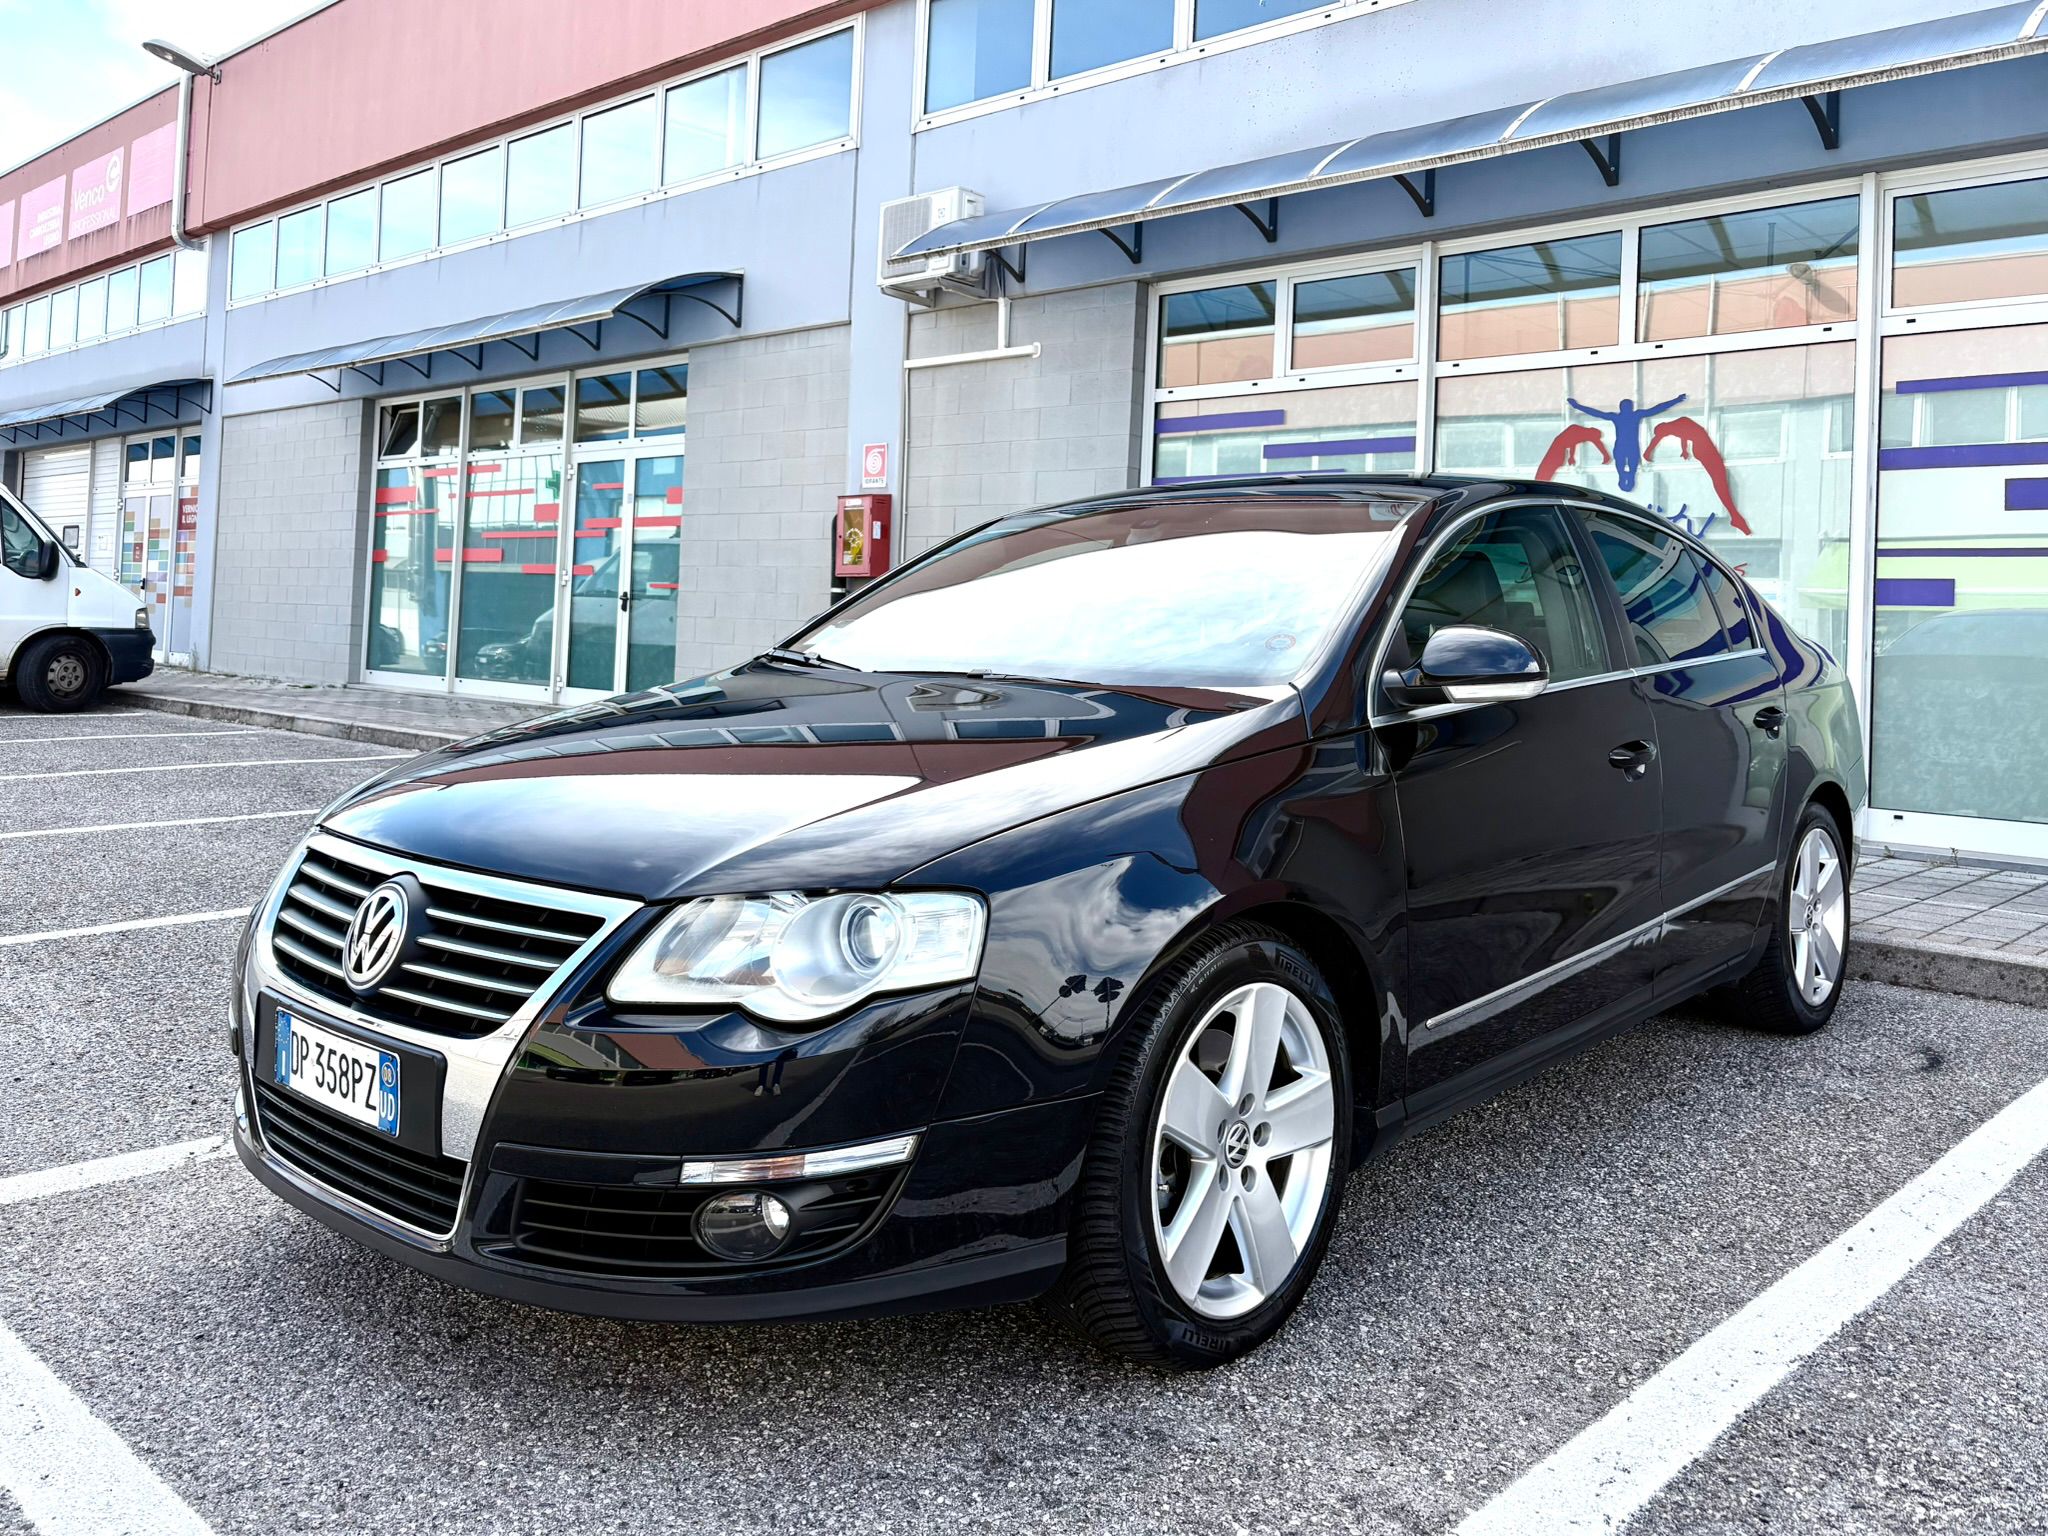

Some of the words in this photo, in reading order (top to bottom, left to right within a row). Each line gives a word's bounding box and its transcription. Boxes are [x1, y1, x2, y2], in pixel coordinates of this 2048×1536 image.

[74, 185, 104, 212] Venco
[291, 1030, 310, 1079] DP
[315, 1041, 377, 1112] 358PZ
[379, 1090, 396, 1122] UD
